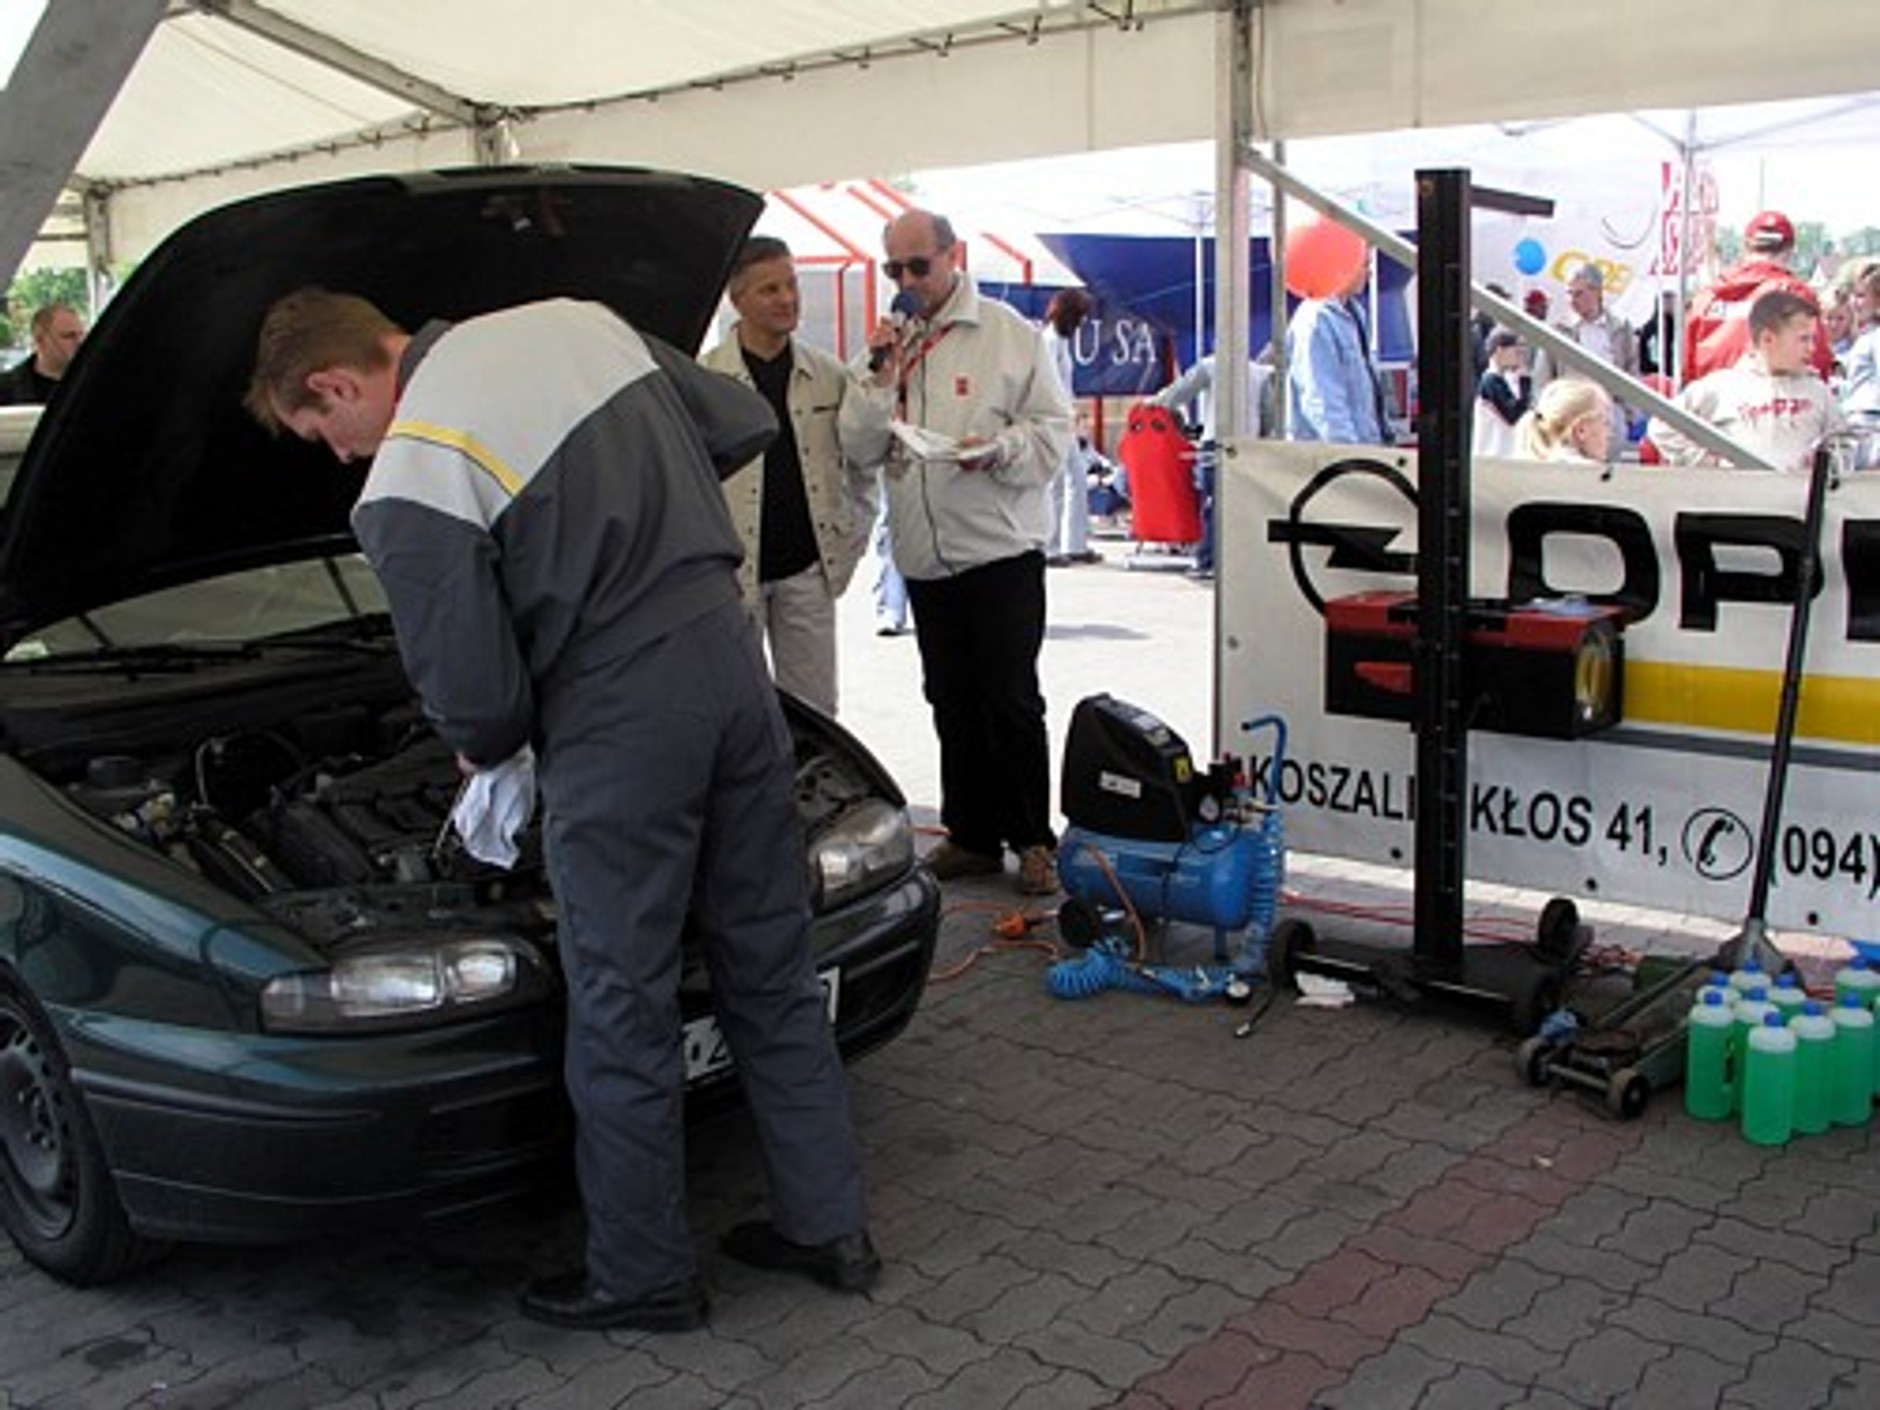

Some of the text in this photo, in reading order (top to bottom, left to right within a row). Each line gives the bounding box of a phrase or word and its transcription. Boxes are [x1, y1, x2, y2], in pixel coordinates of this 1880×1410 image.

[1506, 501, 1880, 641] OP
[1251, 756, 1416, 821] KOSZALI
[1471, 783, 1592, 846] KŁOS
